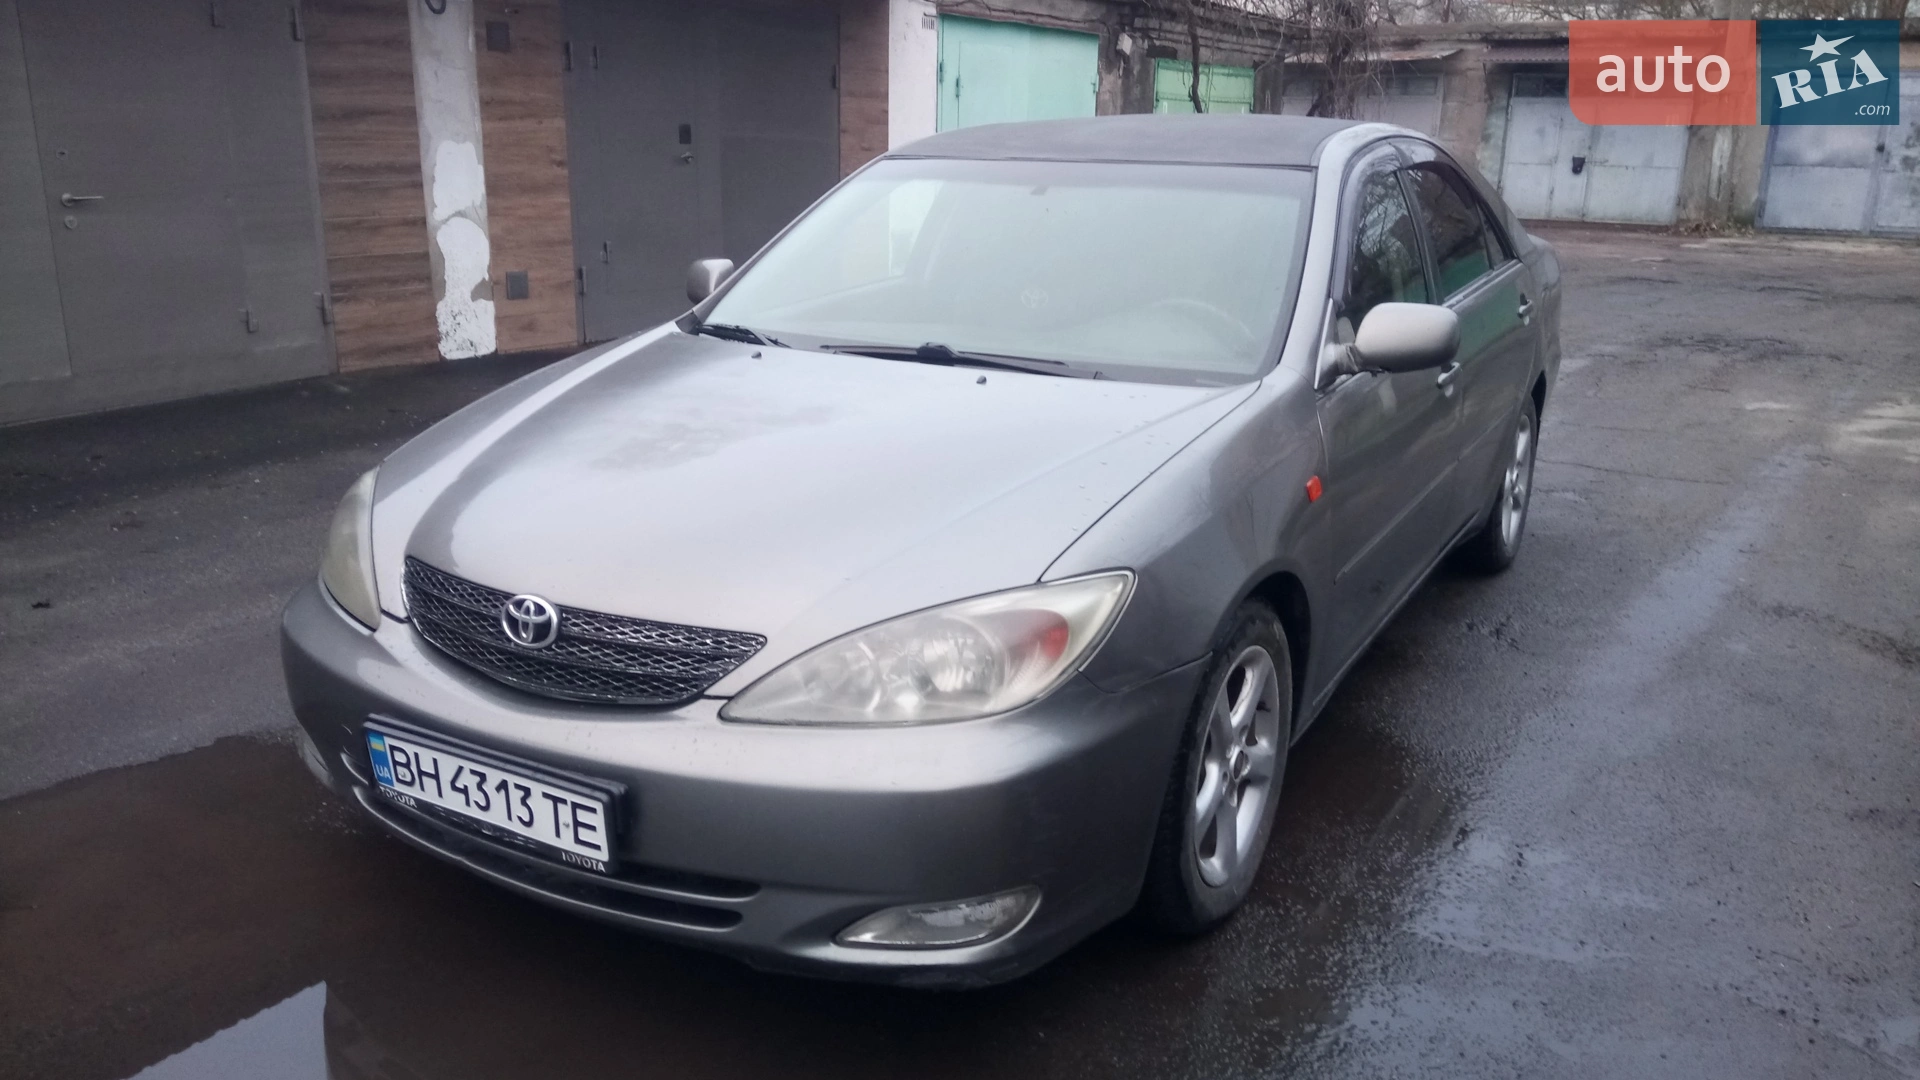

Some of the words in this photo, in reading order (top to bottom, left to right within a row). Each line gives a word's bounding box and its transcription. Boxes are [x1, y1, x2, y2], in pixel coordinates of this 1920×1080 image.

[375, 763, 392, 781] UA
[379, 785, 418, 809] TOYOTA
[388, 743, 444, 799] BH
[450, 765, 535, 828] 4313
[541, 791, 602, 852] TE
[561, 851, 606, 873] TOYOTA
